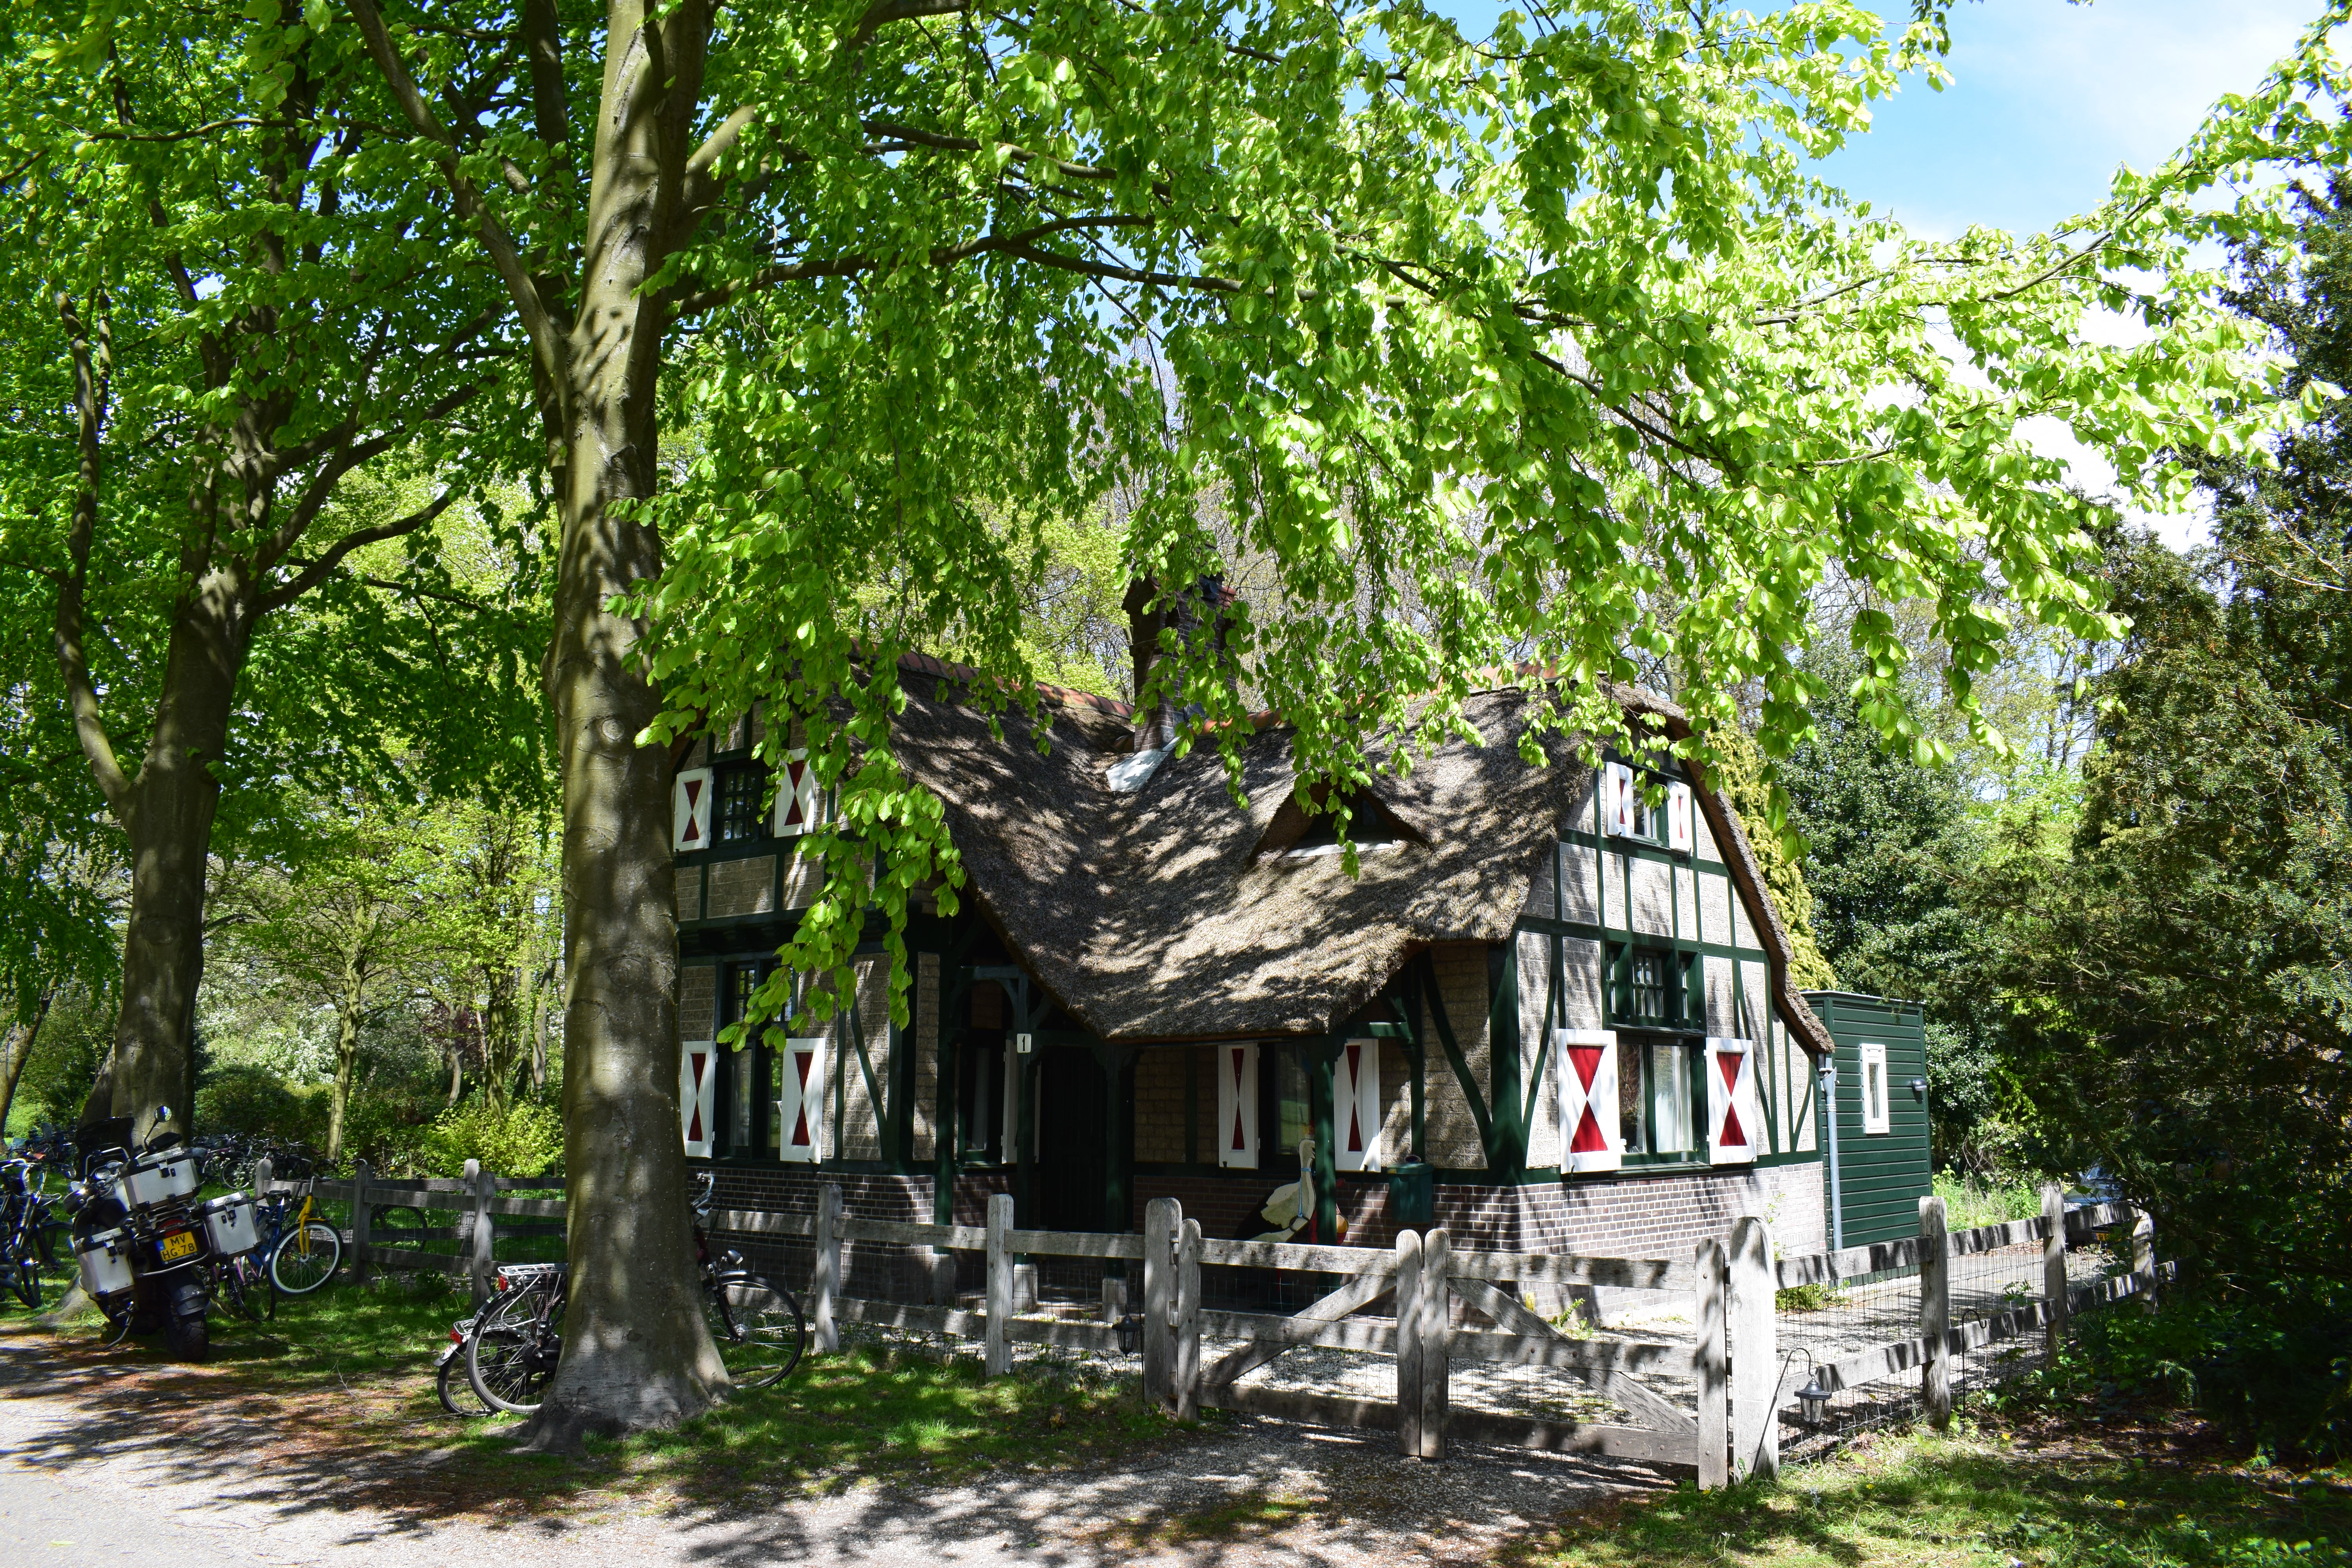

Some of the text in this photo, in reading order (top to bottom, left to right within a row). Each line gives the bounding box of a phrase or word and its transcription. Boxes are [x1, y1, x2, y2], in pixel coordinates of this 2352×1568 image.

[1022, 1035, 1025, 1051] 1
[170, 1234, 185, 1246] MV
[162, 1243, 195, 1259] HG-78
